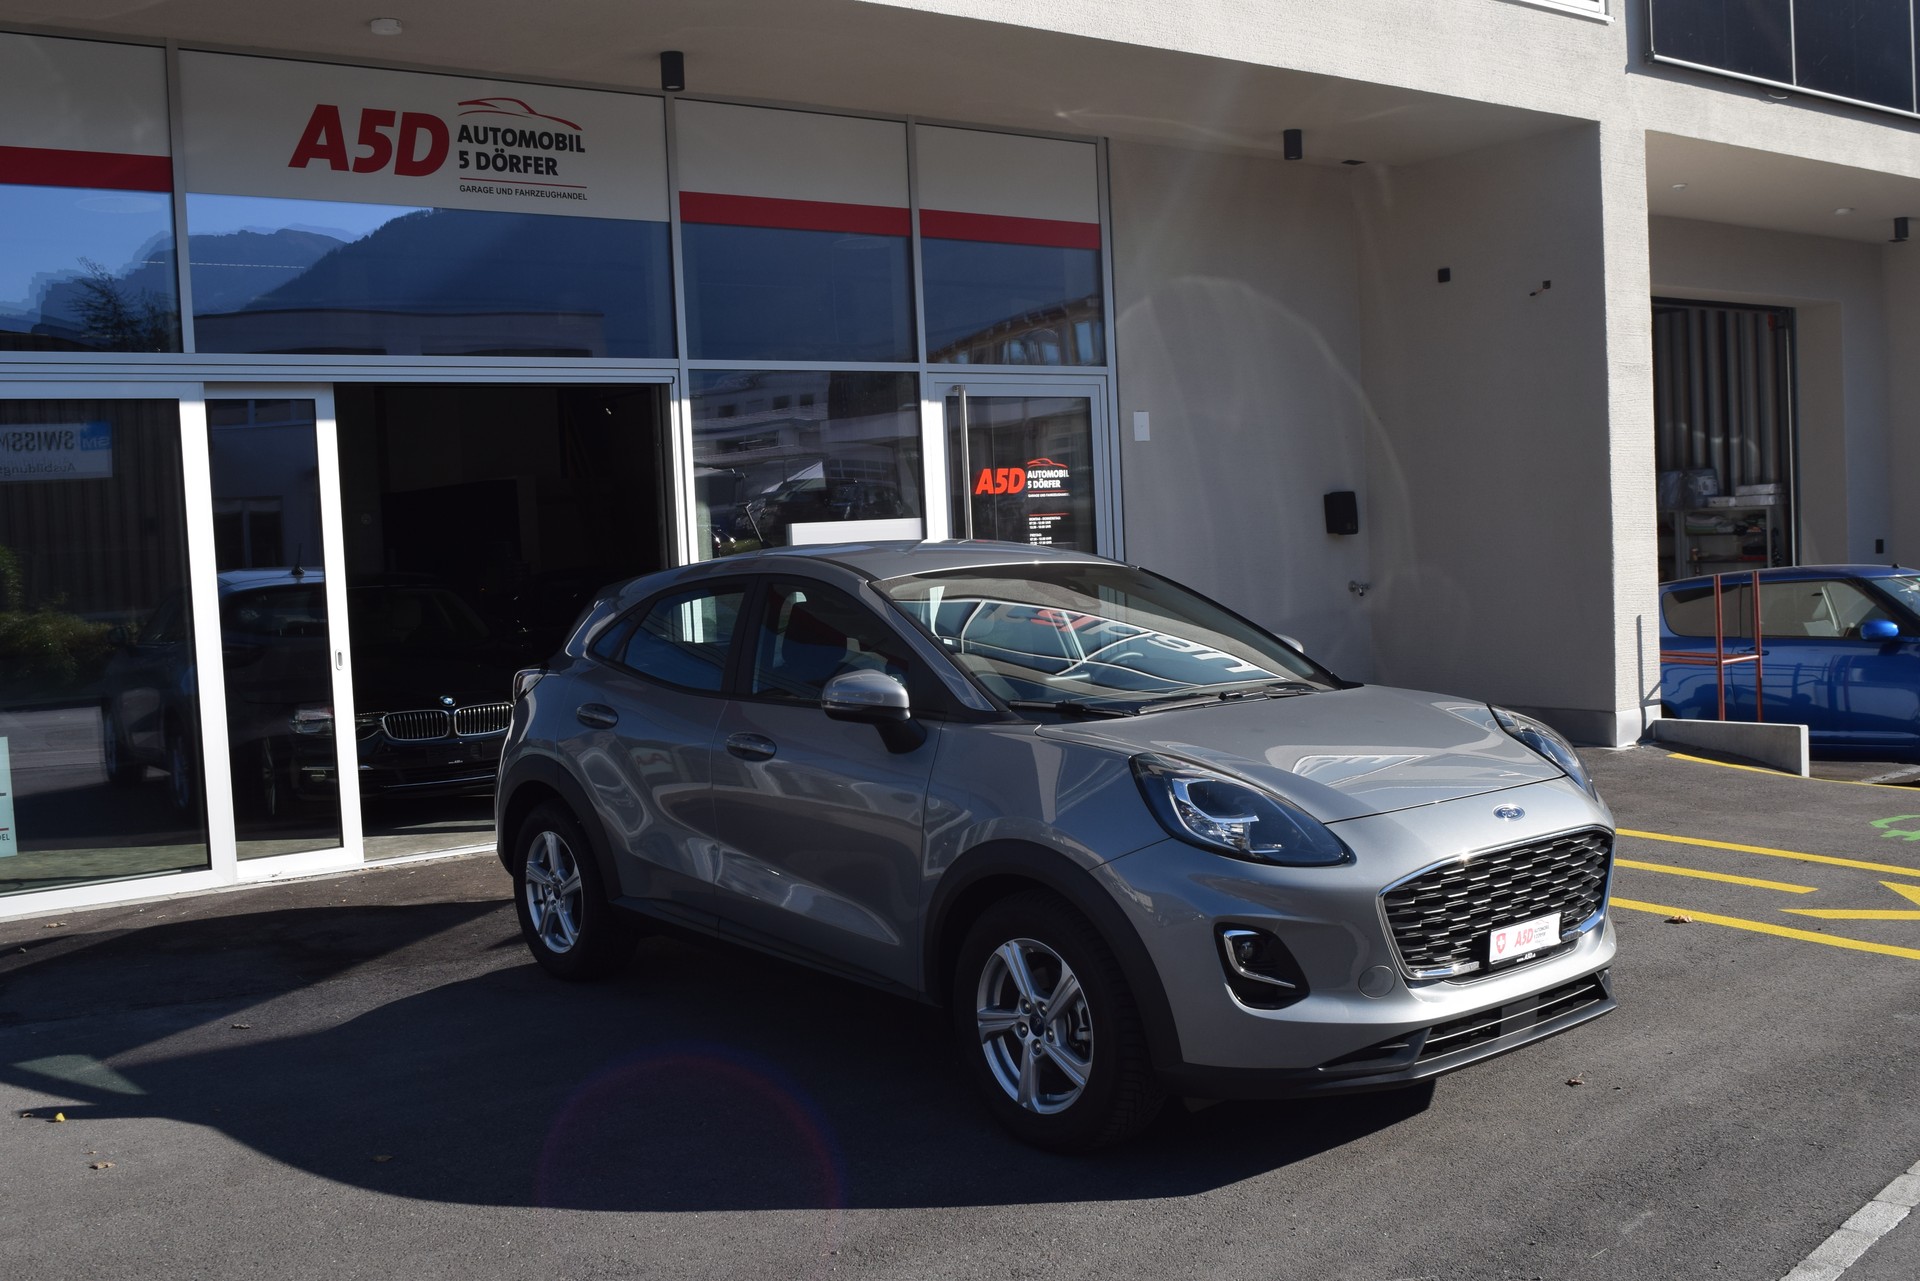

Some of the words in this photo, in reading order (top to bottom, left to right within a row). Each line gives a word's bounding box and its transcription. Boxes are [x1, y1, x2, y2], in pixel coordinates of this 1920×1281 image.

[288, 103, 450, 177] A5D
[457, 124, 586, 153] AUTOMOBIL
[459, 150, 470, 169] 5
[475, 147, 559, 176] DÖRFER
[459, 184, 494, 195] GARAGE
[495, 187, 513, 196] UND
[514, 188, 588, 201] FAHRZEUGHANDEL
[975, 467, 1026, 495] A5D
[1027, 469, 1070, 479] AUTOMOBIL
[1027, 480, 1033, 489] 5
[1033, 479, 1061, 488] DÖRFER
[1514, 928, 1534, 948] A5D
